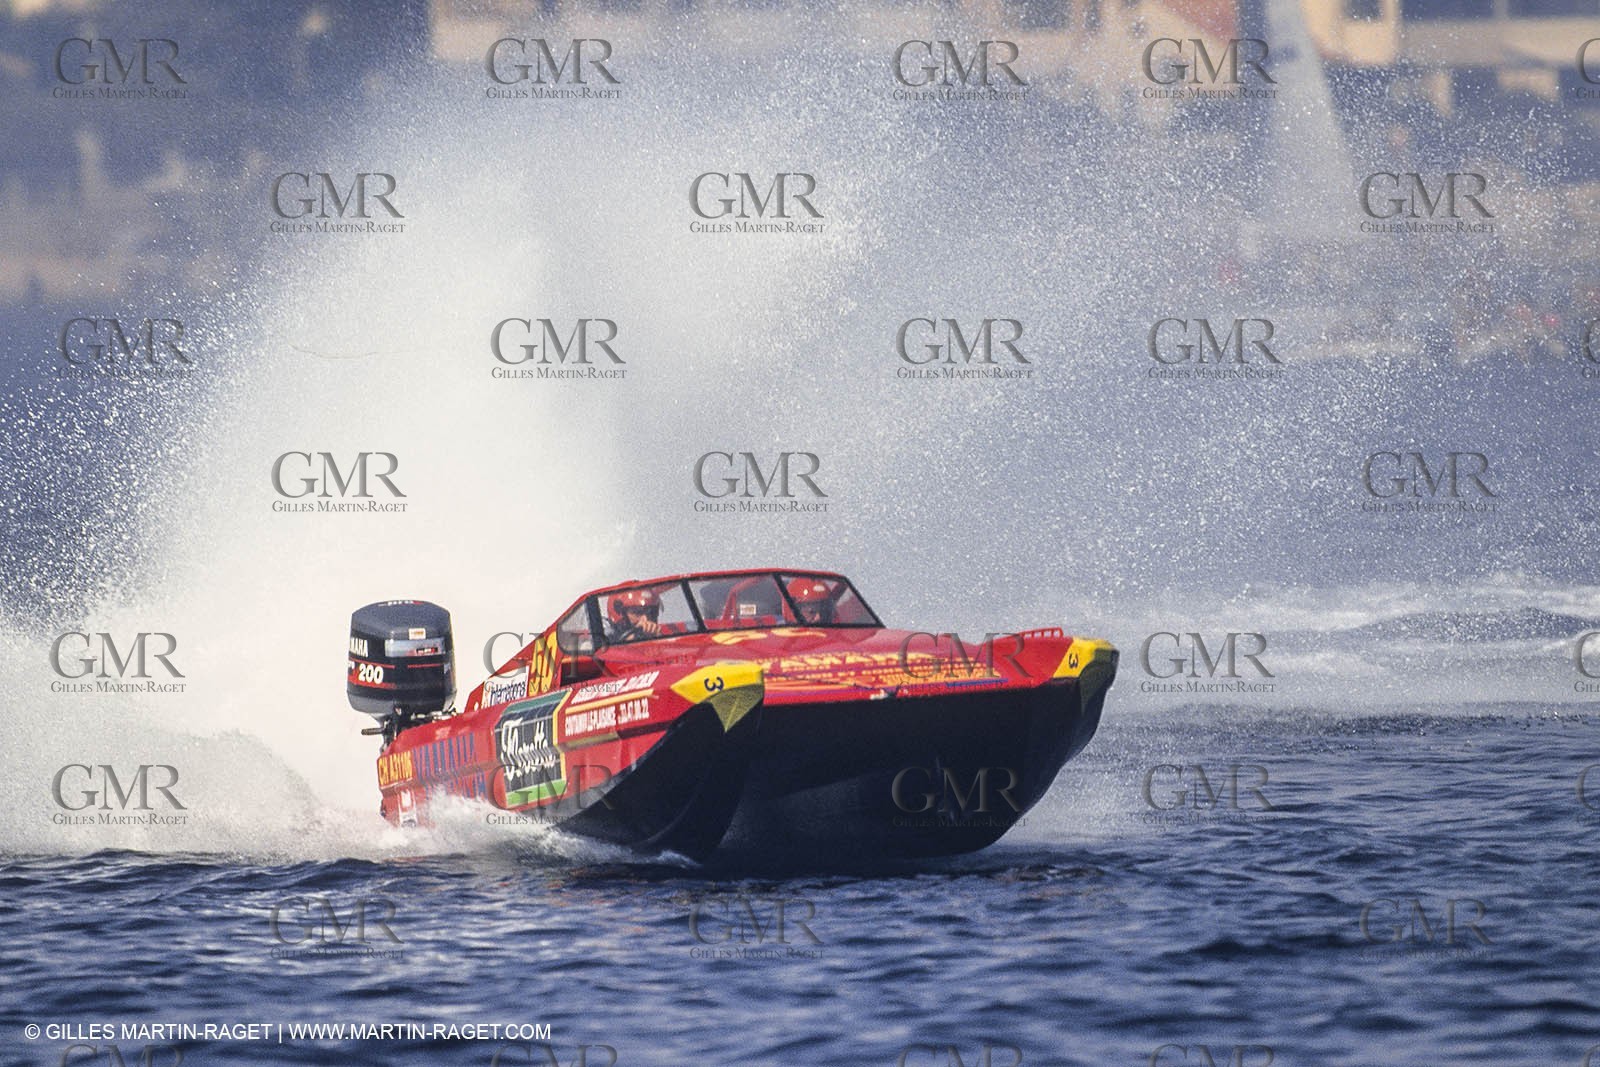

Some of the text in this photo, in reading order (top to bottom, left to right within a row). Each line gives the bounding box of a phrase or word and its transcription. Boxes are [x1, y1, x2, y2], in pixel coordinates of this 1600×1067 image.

[1068, 653, 1079, 669] 3
[358, 663, 384, 684] 200
[704, 676, 724, 692] 3
